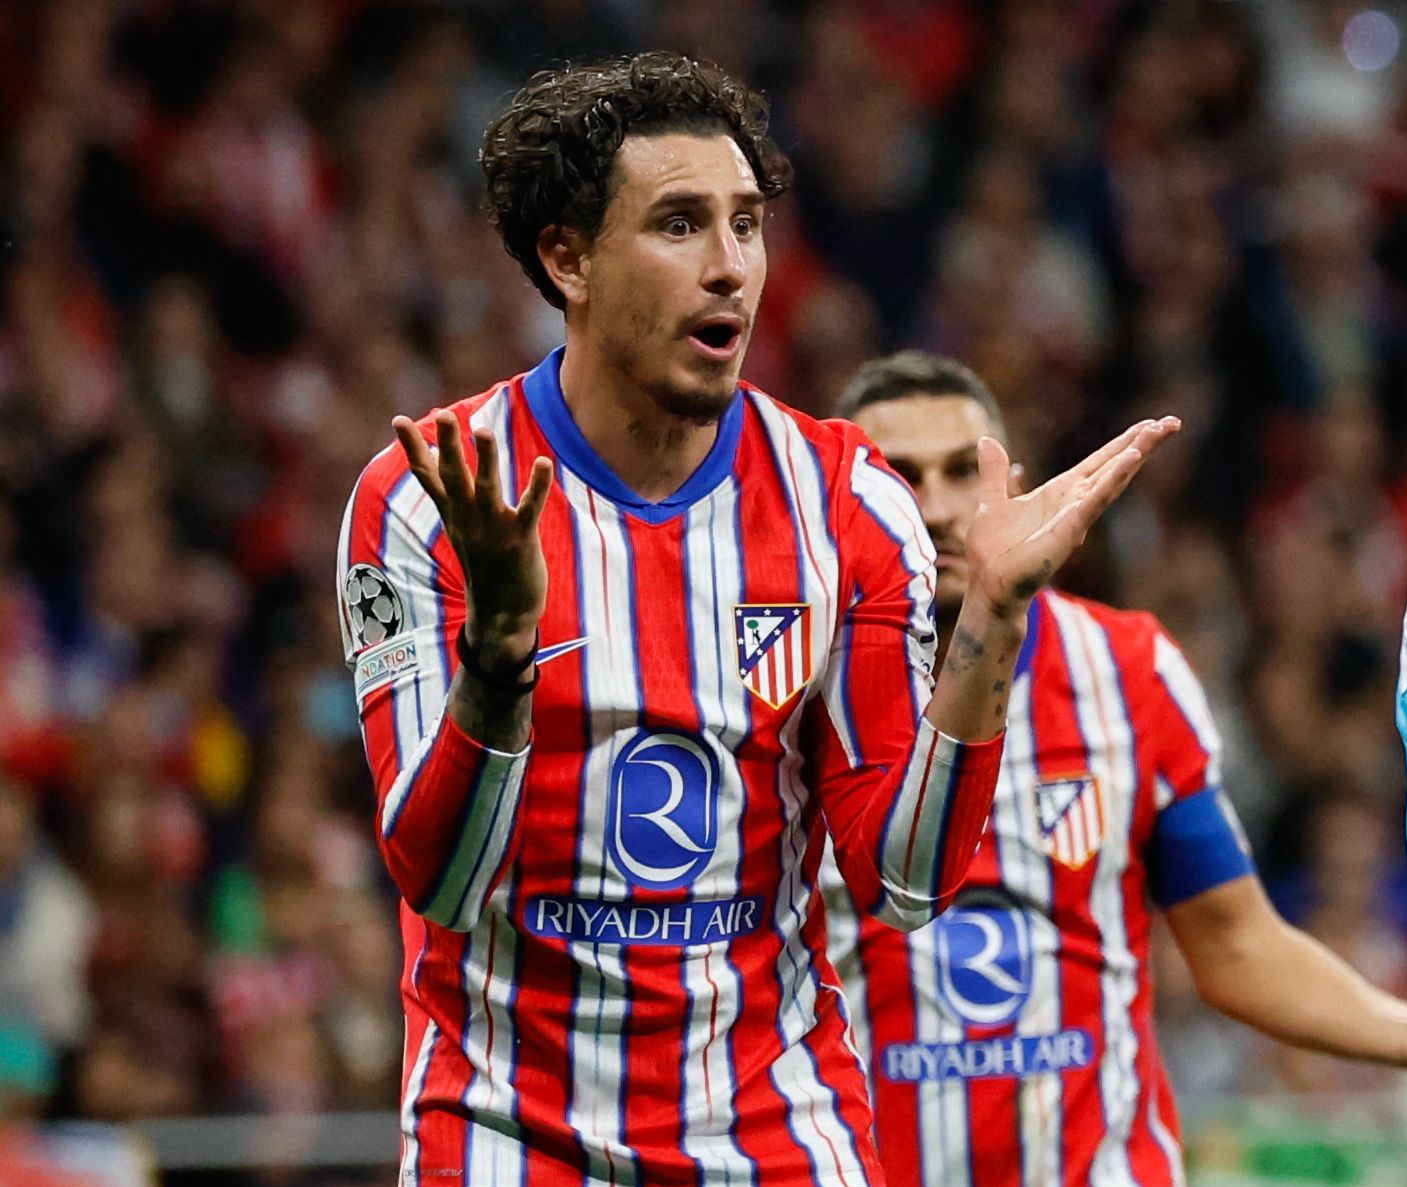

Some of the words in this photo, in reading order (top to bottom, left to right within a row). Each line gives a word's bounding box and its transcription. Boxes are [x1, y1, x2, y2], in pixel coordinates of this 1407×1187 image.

[361, 643, 417, 678] NDATION
[536, 898, 692, 941] RIYADH
[702, 899, 756, 940] AIR
[886, 1036, 1025, 1081] RIYADH
[1034, 1030, 1088, 1071] AIR
